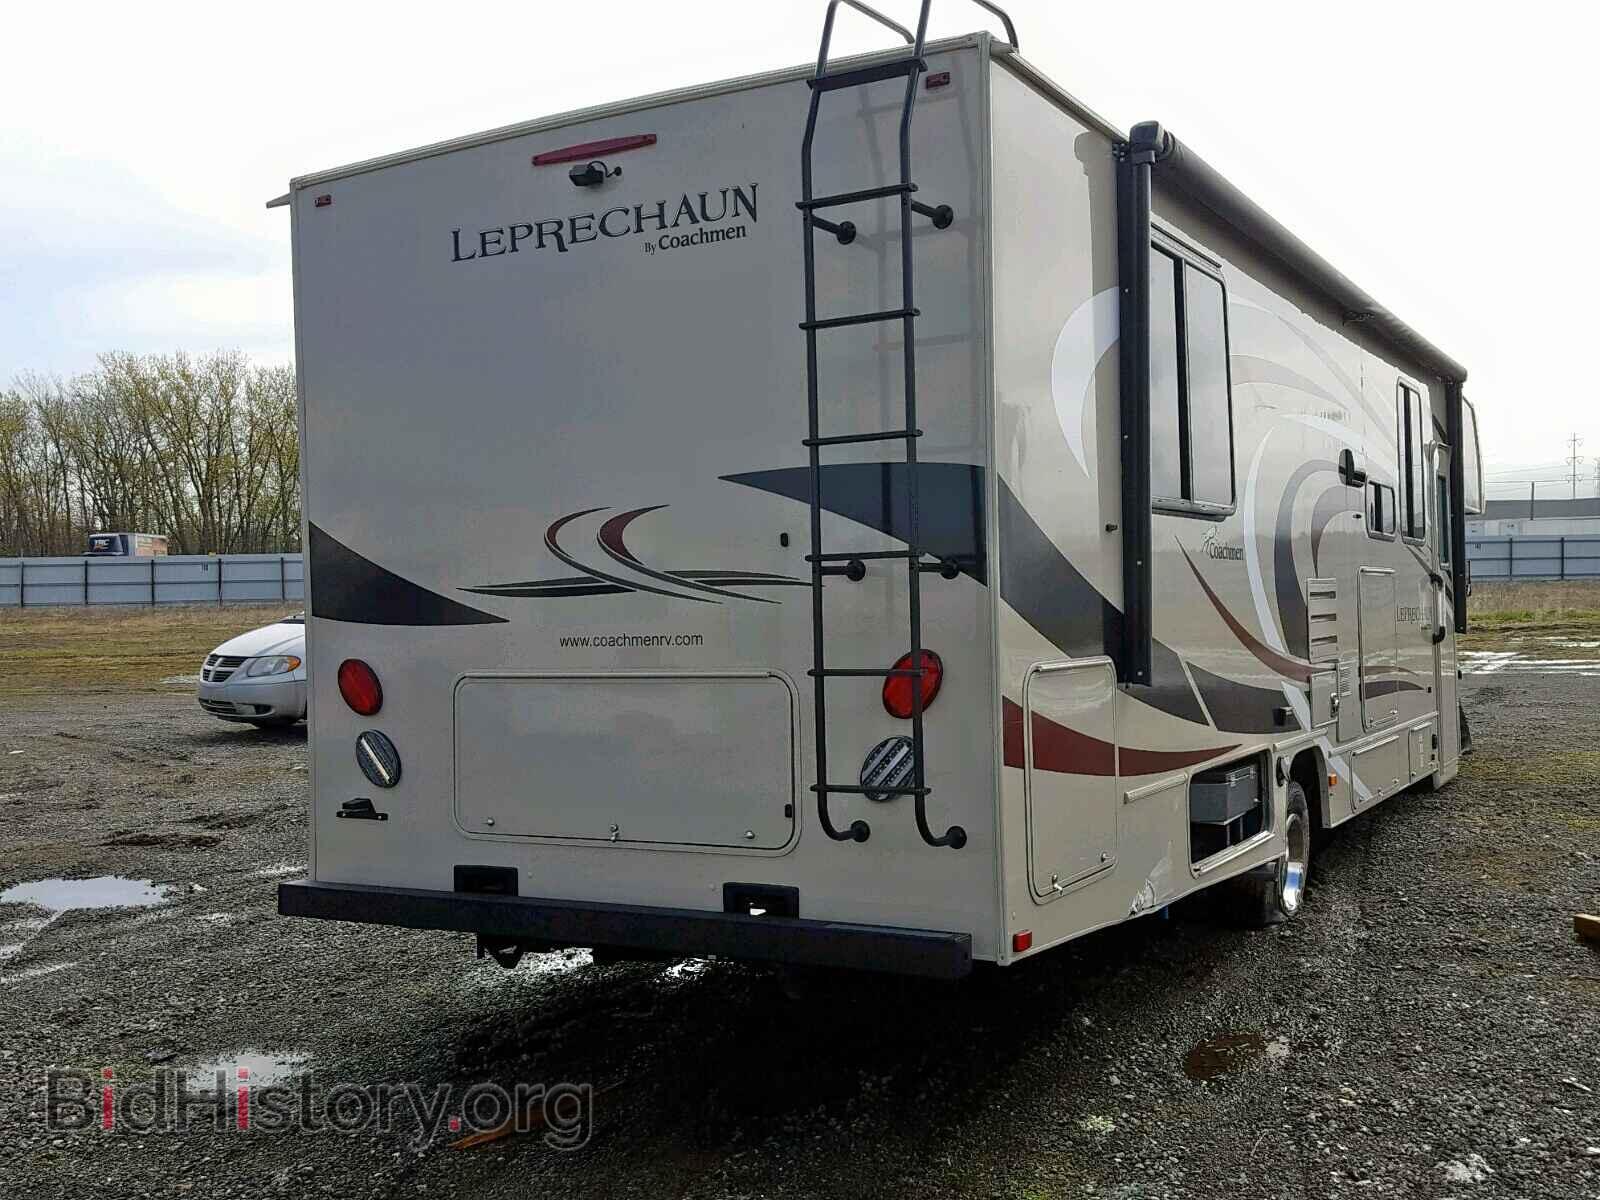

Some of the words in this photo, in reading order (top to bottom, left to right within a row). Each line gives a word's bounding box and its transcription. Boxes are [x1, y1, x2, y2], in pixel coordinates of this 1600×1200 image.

[451, 183, 759, 262] LEPRECHAUN
[658, 225, 746, 250] Coachmen
[1209, 541, 1244, 561] Coachmen
[559, 632, 704, 648] www.coachmenrv.com
